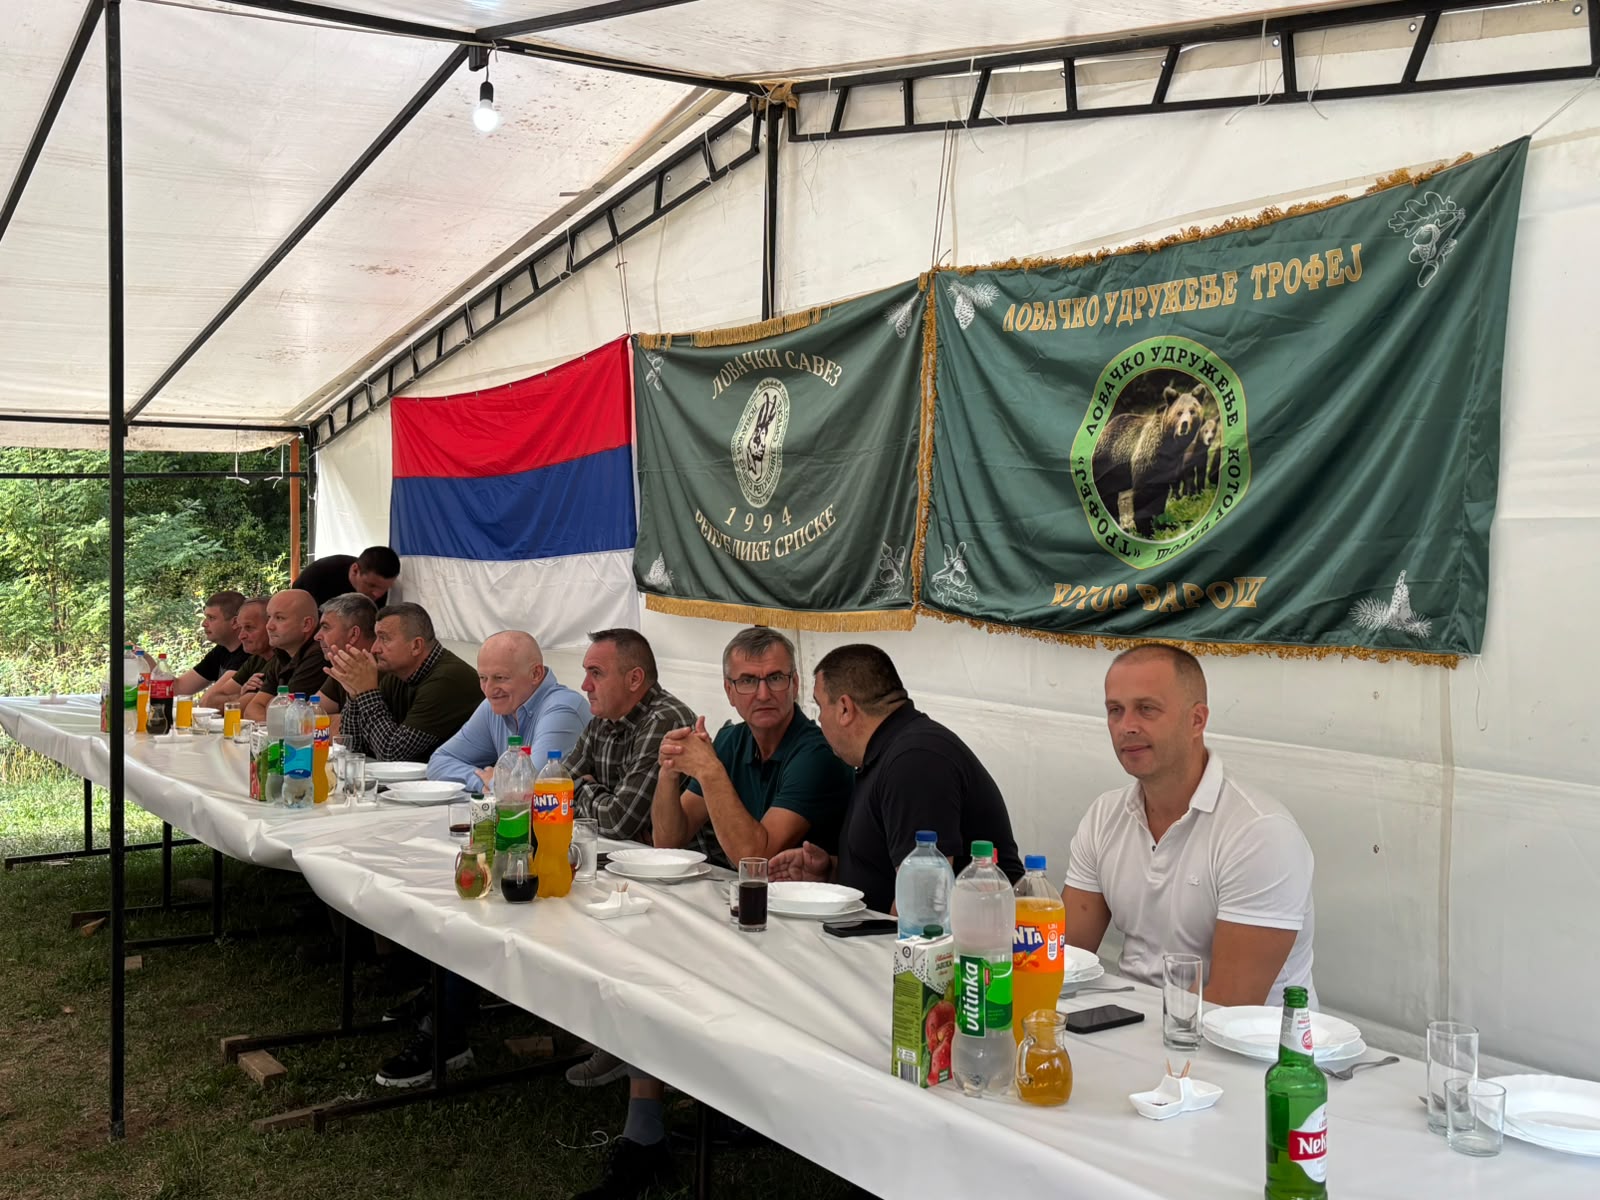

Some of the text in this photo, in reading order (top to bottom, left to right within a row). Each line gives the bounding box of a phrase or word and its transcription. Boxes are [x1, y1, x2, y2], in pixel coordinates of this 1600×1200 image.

[1002, 243, 1364, 332] ЛОВАЧКО УДРУЖЕЊЕ ТРОФЕЈ
[712, 349, 843, 400] ЛОВАЧКИ САВЕЗ
[1086, 351, 1146, 437] ЛОВАЧКО
[1150, 346, 1240, 428] УДРУЖЕЊЕ
[1214, 447, 1241, 522] КОТОР
[724, 506, 792, 534] 1994
[774, 504, 837, 558] СРПСКЕ
[1136, 576, 1268, 613] ВАРОШ
[1012, 925, 1044, 945] NTA
[963, 961, 979, 1032] vitinka
